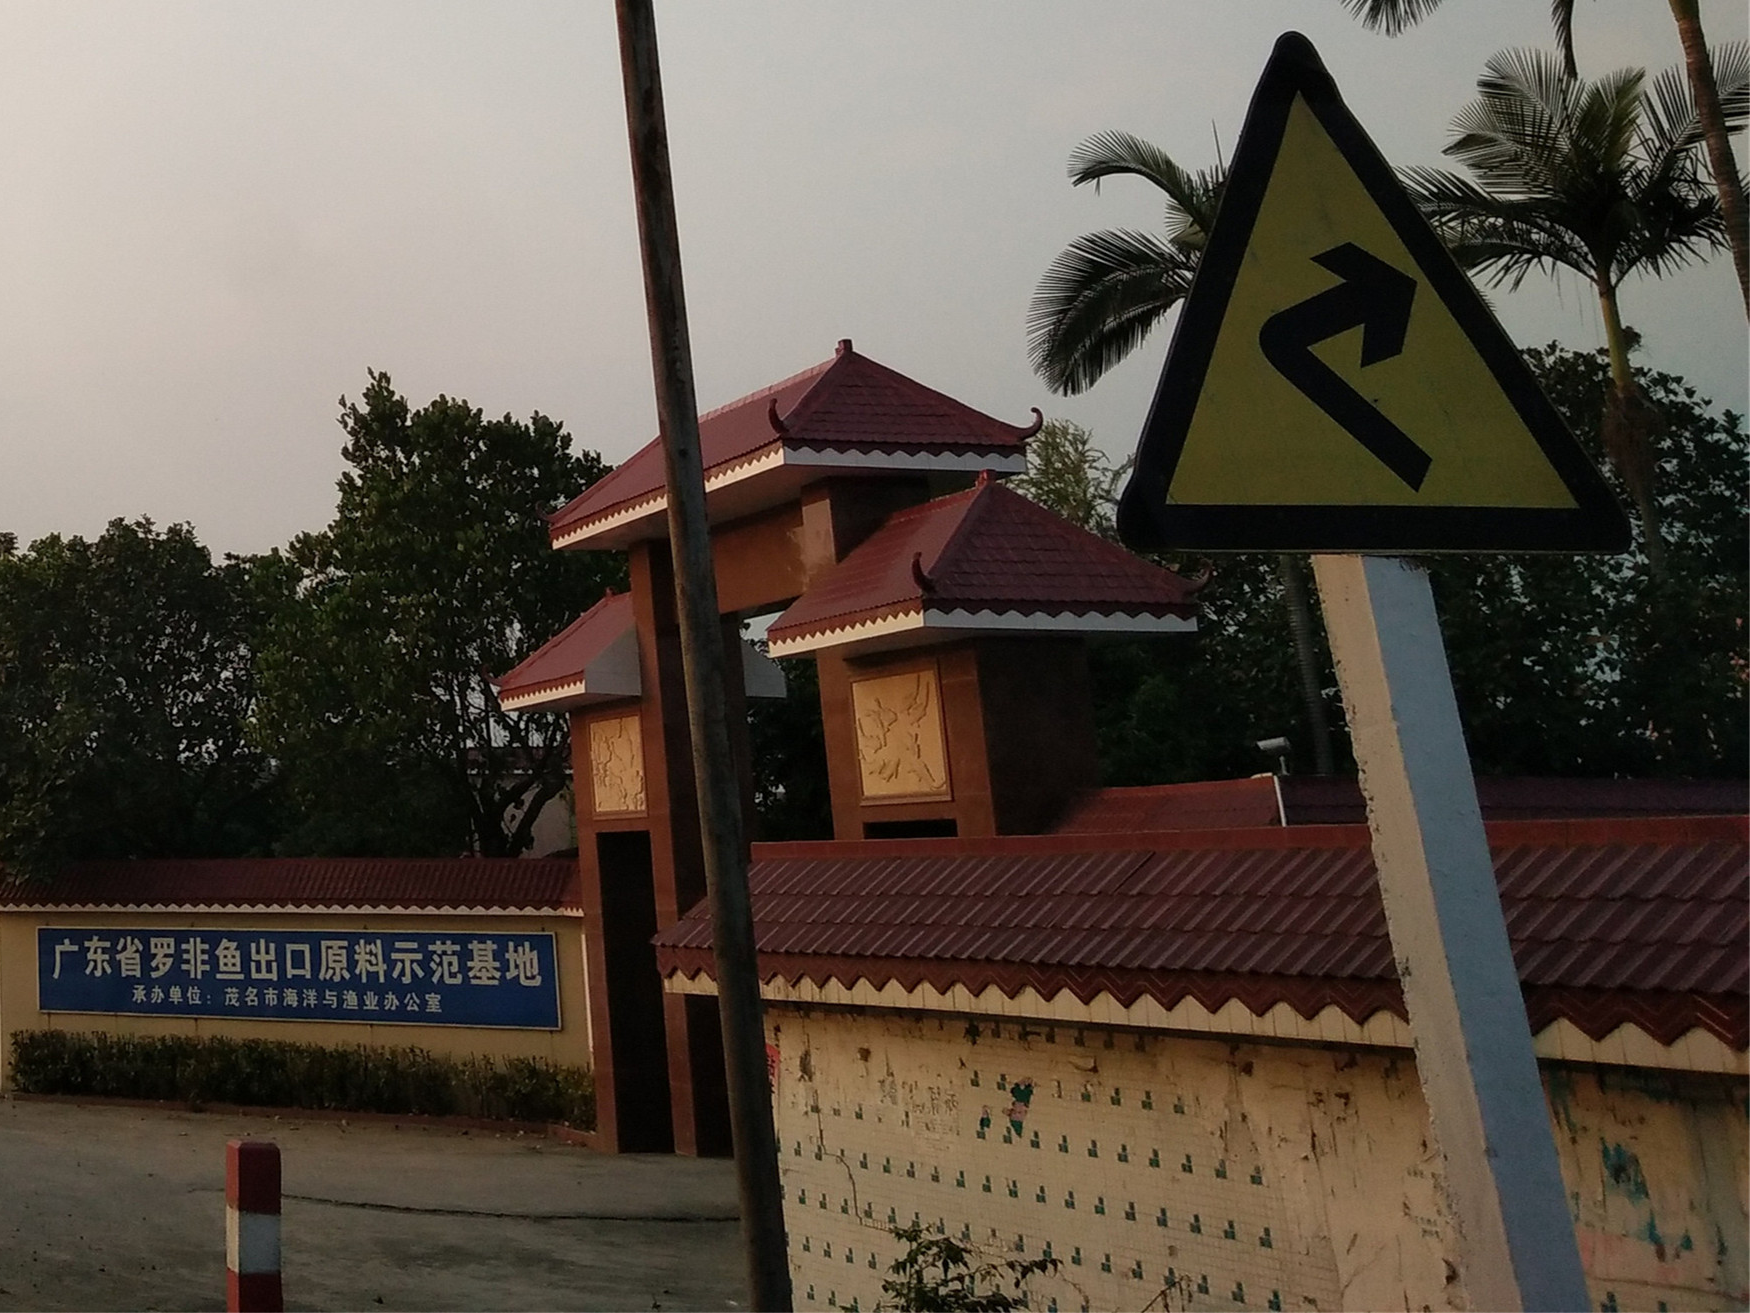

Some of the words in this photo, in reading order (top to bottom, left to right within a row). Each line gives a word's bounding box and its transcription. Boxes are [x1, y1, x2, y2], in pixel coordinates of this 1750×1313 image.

[52, 936, 543, 987] 广东省罗非鱼出口原料示范基地
